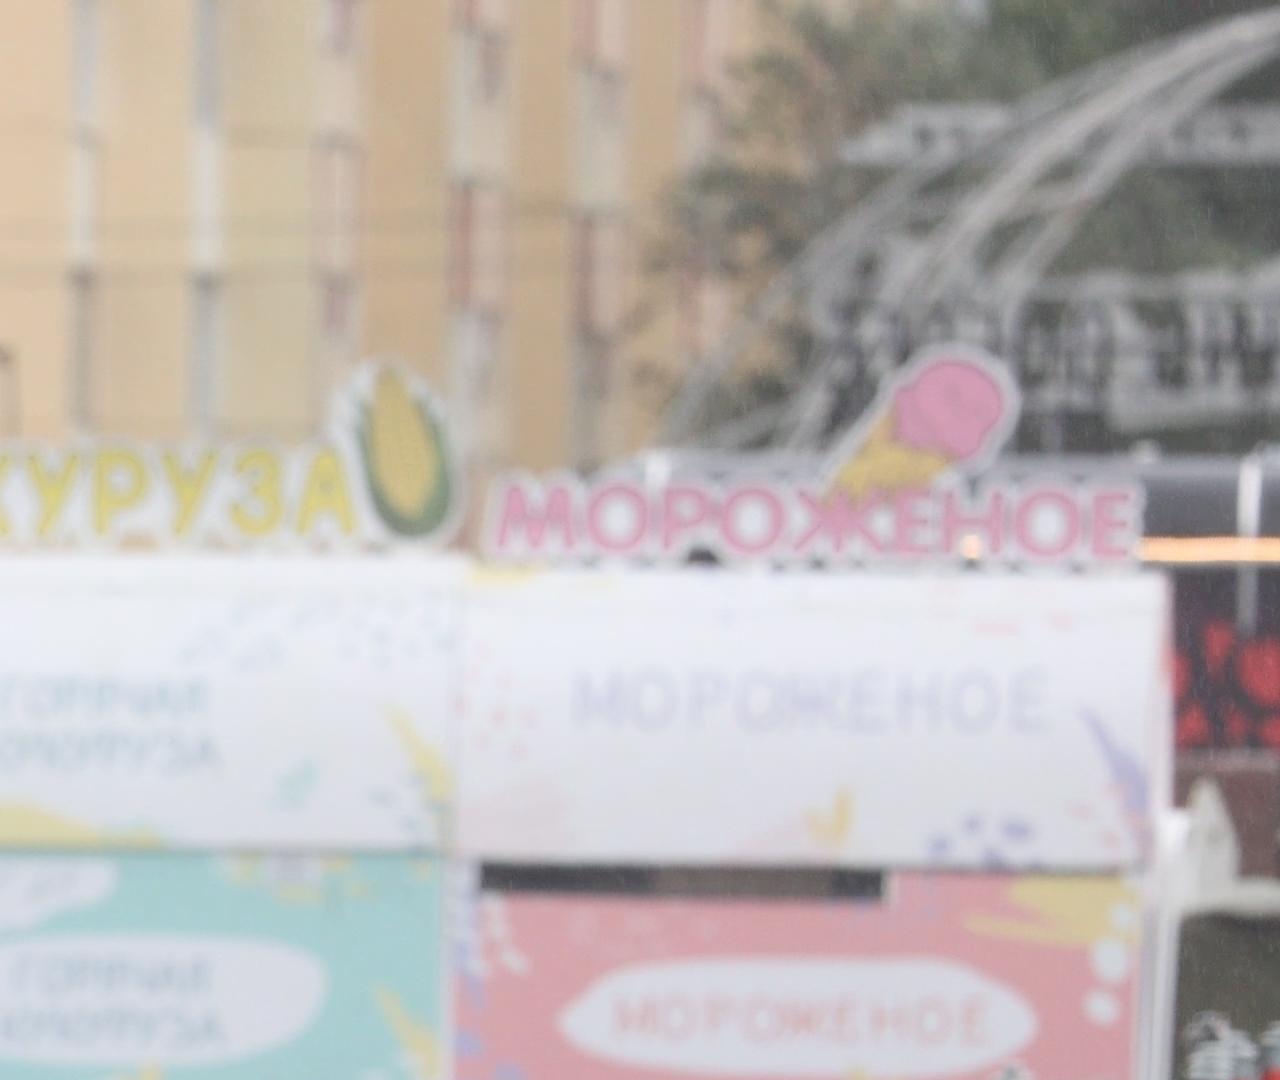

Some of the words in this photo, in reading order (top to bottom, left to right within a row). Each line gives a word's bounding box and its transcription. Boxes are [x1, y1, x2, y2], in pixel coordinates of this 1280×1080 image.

[496, 482, 1136, 558] МОРОЖЕНОЕ
[574, 666, 1046, 733] МОРОЖЕНОЕ
[612, 994, 990, 1050] МОРОЖЕНОЕ
